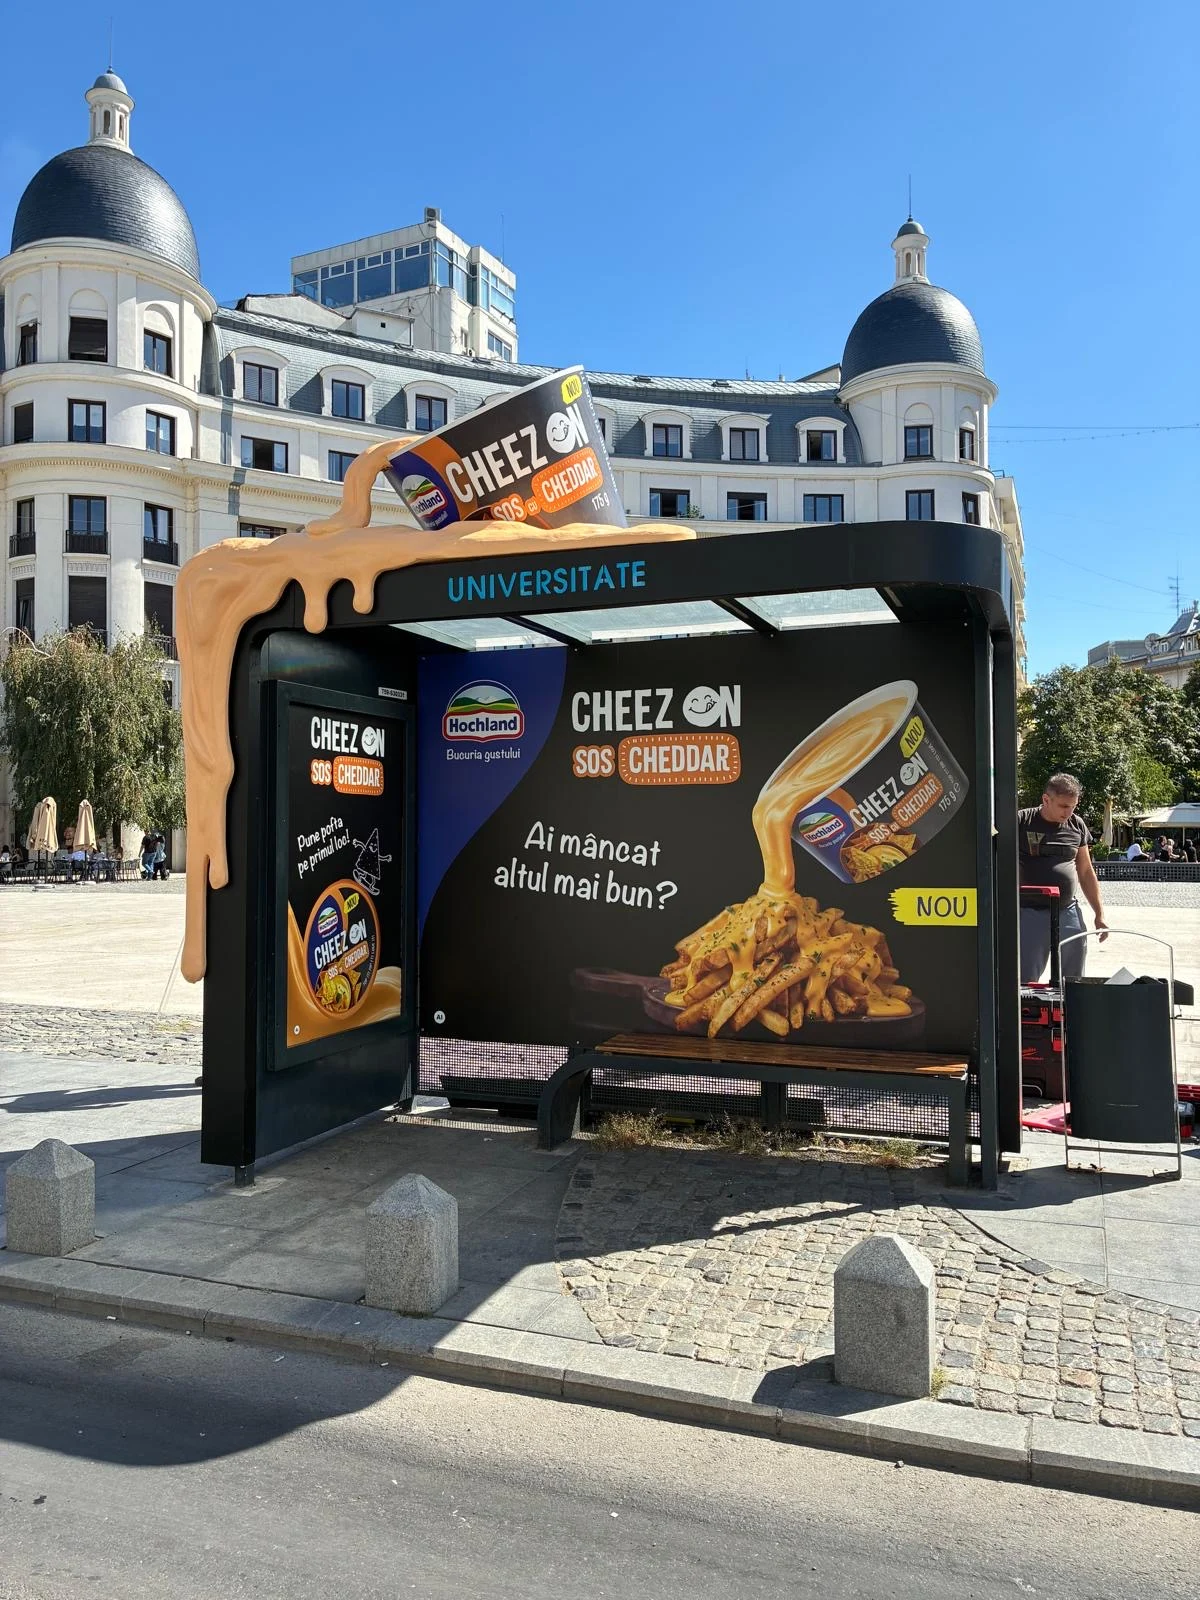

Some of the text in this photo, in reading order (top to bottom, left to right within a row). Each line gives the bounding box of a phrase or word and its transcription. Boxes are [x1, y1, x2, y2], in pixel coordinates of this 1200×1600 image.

[565, 376, 581, 398] NOU
[445, 423, 549, 503] CHEEZ
[411, 490, 443, 514] chland
[493, 496, 525, 522] SOS
[541, 456, 598, 503] CHEDDAR
[447, 560, 646, 602] UNIVERSITATE
[449, 716, 518, 733] Hochland
[571, 687, 674, 733] CHEEZ
[311, 716, 359, 754] CHEEZ
[904, 722, 923, 750] NOU
[446, 747, 521, 762] Bucuria gustului
[575, 744, 731, 775] SOS CHEDDAR
[312, 761, 381, 788] SOS CHEDDAR
[849, 776, 905, 829] CHEEZ
[869, 824, 890, 843] SOS
[898, 780, 939, 823] CHEDDAR
[297, 816, 344, 852] Pune pofta
[523, 821, 662, 867] Ai mâncat
[805, 820, 842, 841] Hochland
[297, 860, 309, 880] pe
[309, 838, 335, 872] primul
[493, 857, 679, 910] altul mai bun?
[916, 896, 968, 918] NOU
[314, 930, 349, 969] CHEEZ
